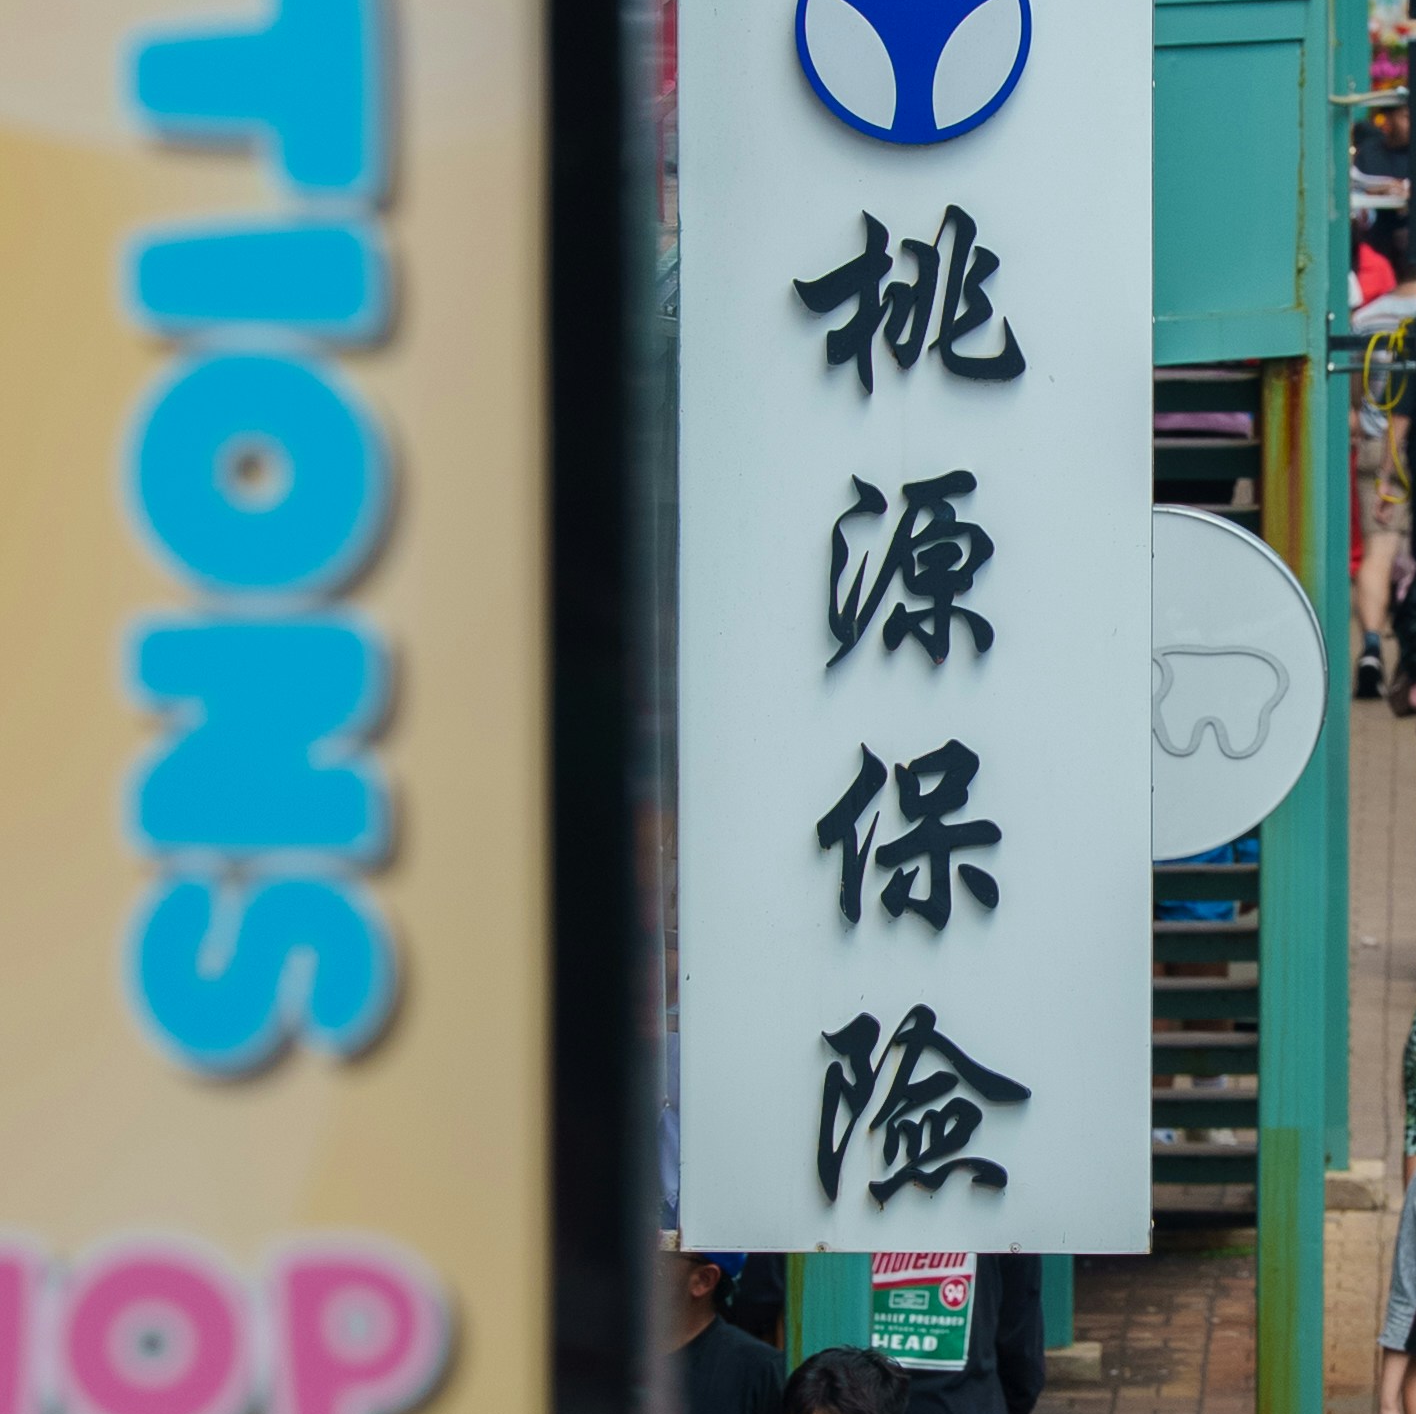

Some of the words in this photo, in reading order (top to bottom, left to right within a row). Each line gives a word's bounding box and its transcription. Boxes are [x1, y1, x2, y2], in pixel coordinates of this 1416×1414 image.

[793, 204, 1031, 1206] 桃源保險
[871, 1333, 939, 1352] HEAD
